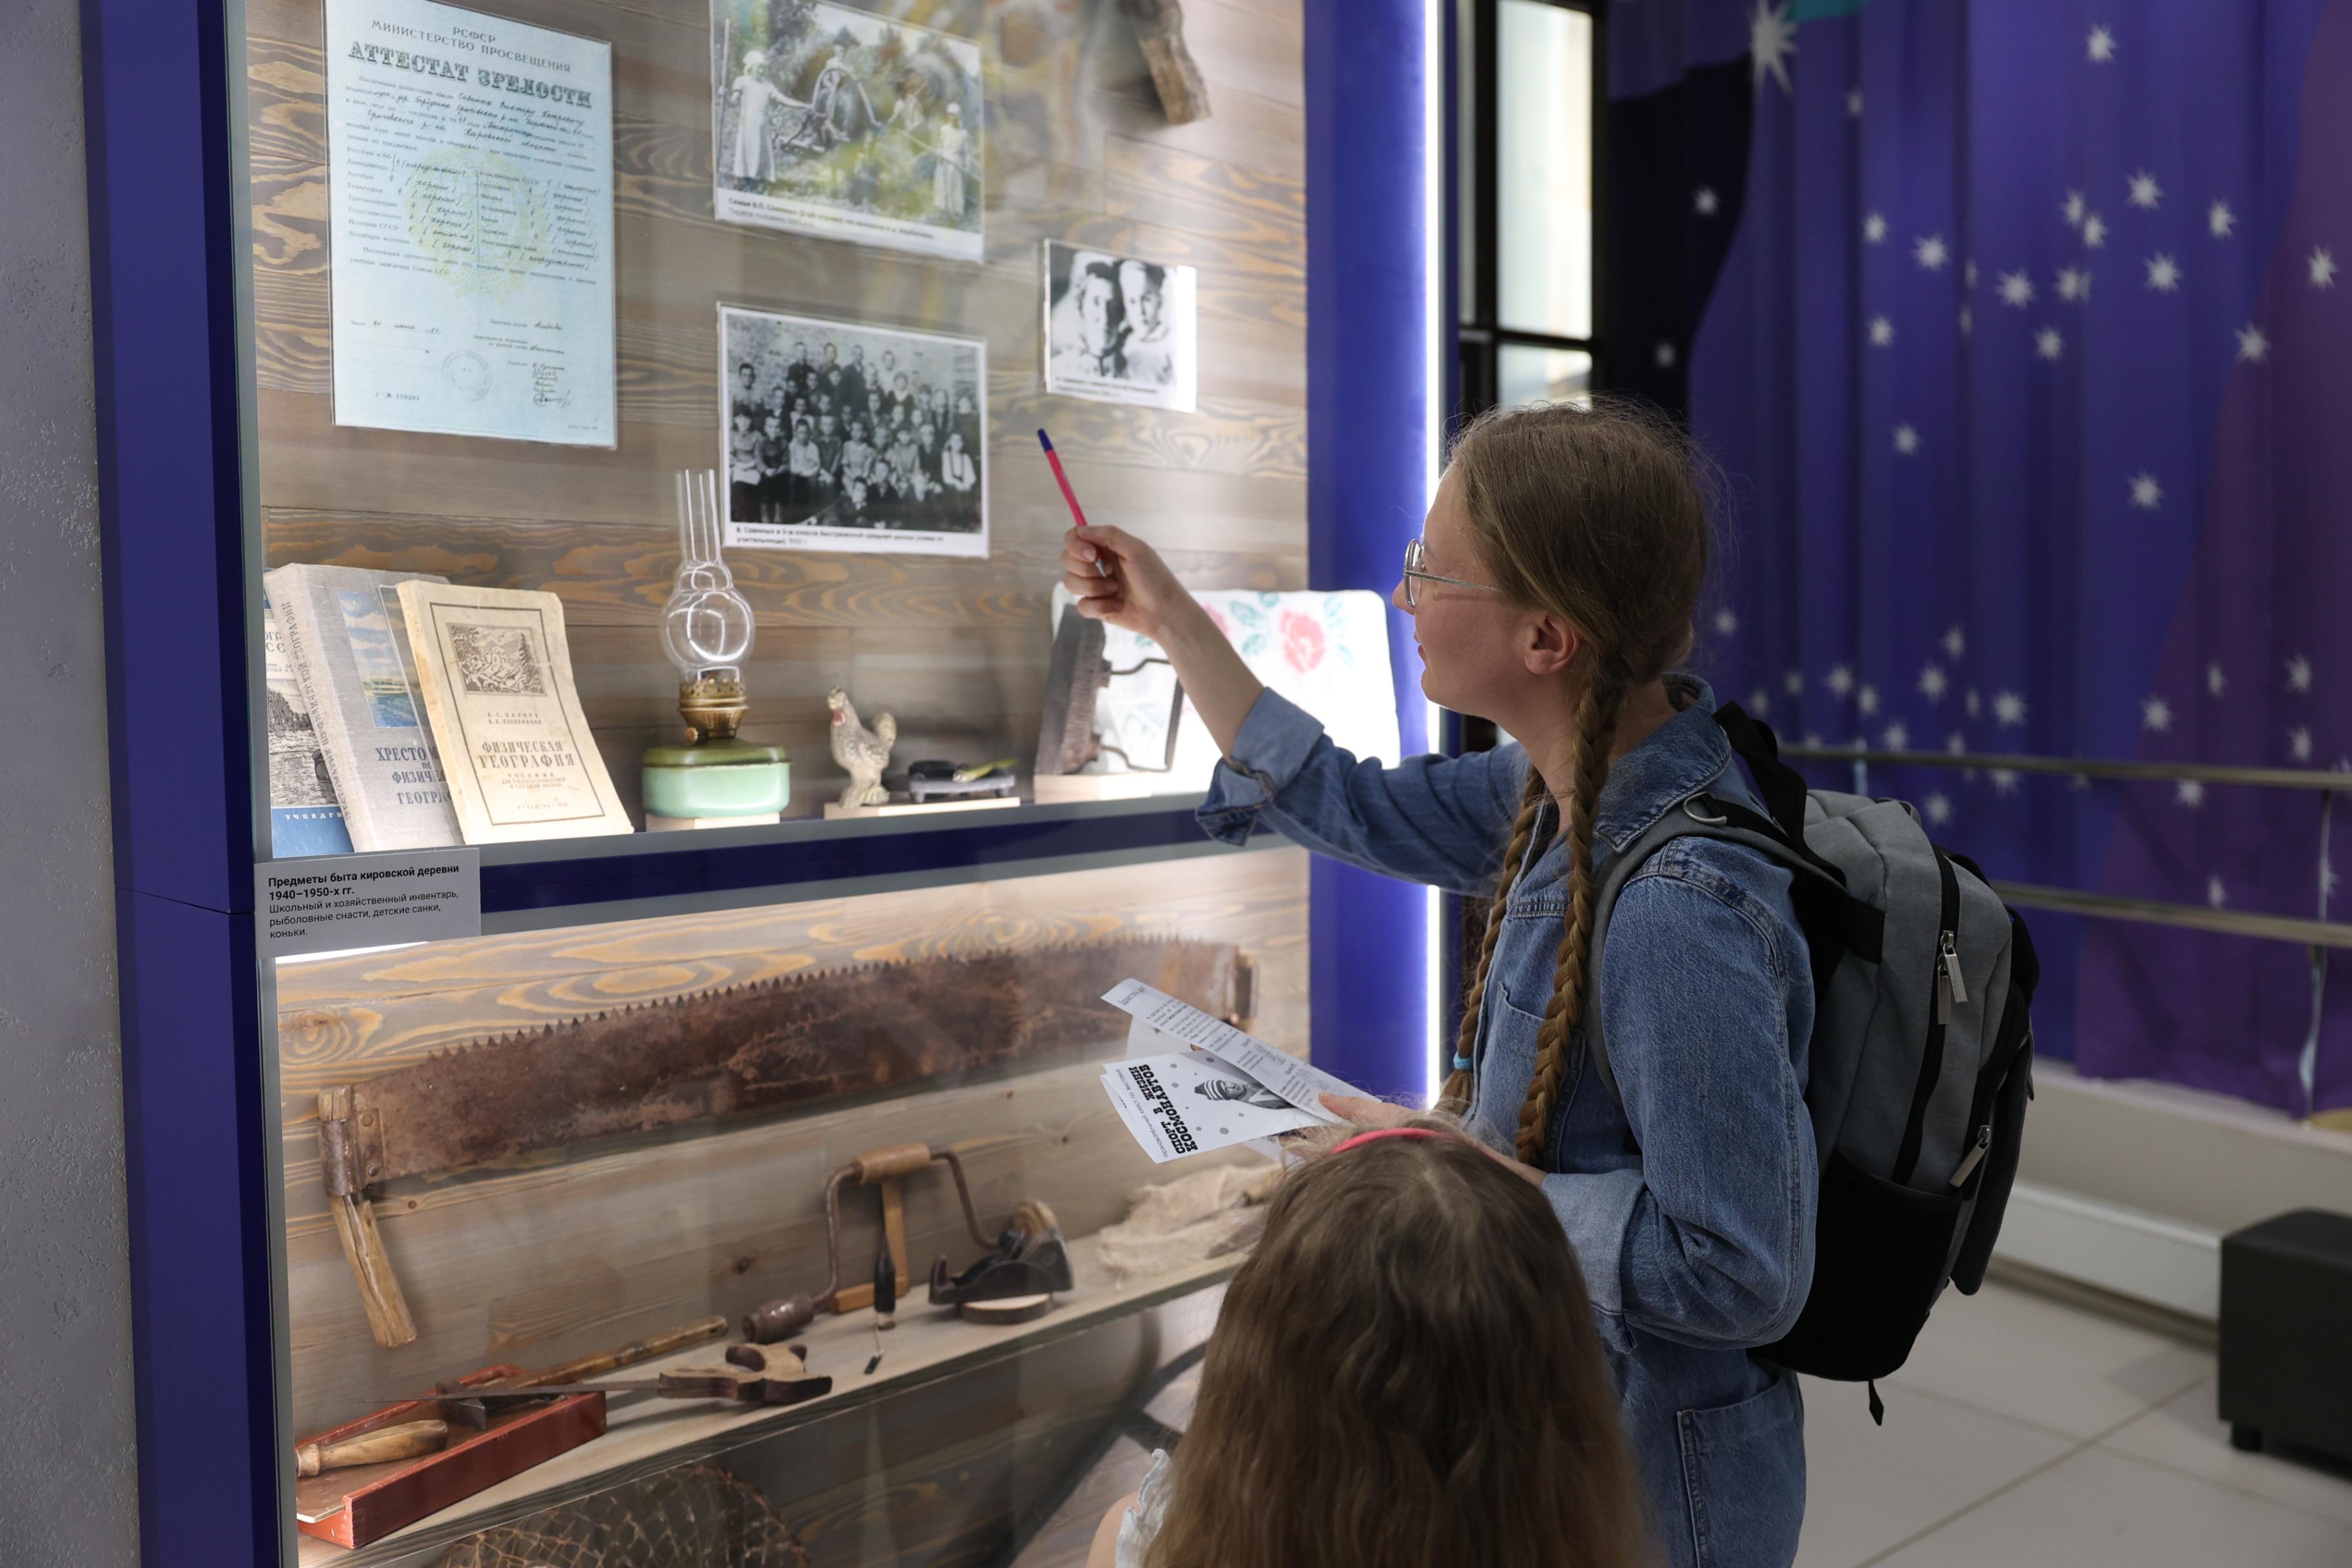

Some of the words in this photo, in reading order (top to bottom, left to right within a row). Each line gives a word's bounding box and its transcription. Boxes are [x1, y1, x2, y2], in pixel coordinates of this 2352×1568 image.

[371, 21, 474, 50] МИНИСТЕРСТВО
[482, 45, 571, 72] ПРОСВЕЩЕНИЯ
[453, 26, 495, 43] РСФСР
[348, 41, 469, 83] АТТЕСТАТ
[478, 68, 592, 108] ЗРЕЛОСТИ
[482, 741, 563, 753] ФИЗИЧЕСКАЯ
[478, 754, 575, 769] ГЕОГРАФИЯ
[268, 874, 327, 888] Предметы
[330, 872, 357, 883] быта
[360, 867, 415, 881] кировской
[418, 865, 459, 877] деревни
[270, 901, 323, 914] Школьный
[334, 894, 407, 908] хозяйственный
[409, 890, 458, 901] инвентарь,
[342, 887, 355, 895] гг.
[270, 914, 333, 927] рыболовные
[336, 910, 371, 921] снасти,
[373, 905, 410, 919] детские
[412, 903, 441, 914] санки,
[270, 928, 308, 939] коньки.
[1128, 1066, 1155, 1101] ЖИЗНИ
[1133, 1100, 1144, 1113] квест
[1138, 1064, 1198, 1152] КОСМОНАВТОВ
[1142, 1115, 1168, 1157] познавательный
[1161, 1121, 1186, 1153] СПОРТ
